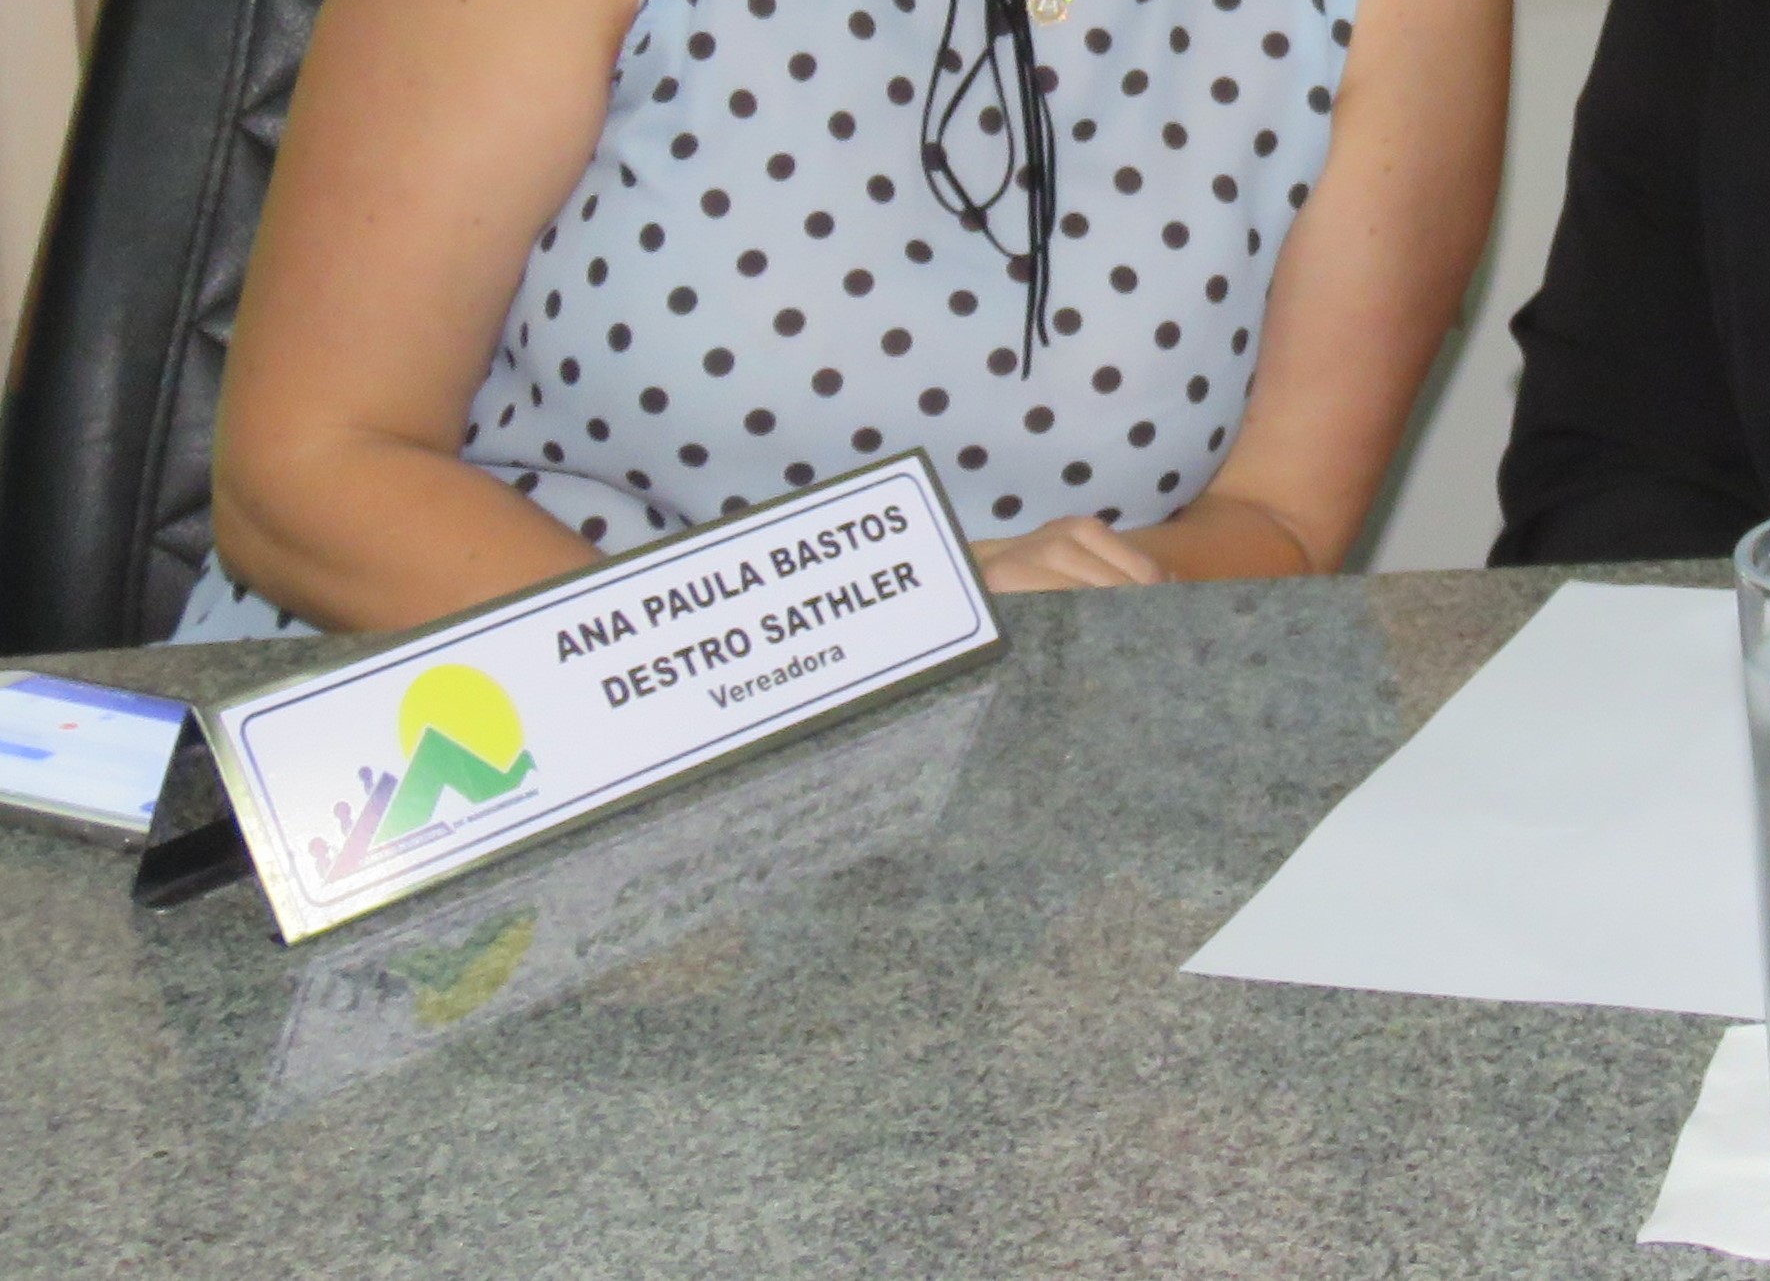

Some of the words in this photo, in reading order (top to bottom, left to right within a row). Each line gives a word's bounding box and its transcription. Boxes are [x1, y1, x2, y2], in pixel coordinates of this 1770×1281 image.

[557, 610, 637, 663] ANA
[642, 561, 765, 627] PAULA
[769, 505, 908, 579] BASTOS
[601, 627, 752, 708] DESTRO
[760, 562, 921, 644] SATHLER
[708, 644, 846, 708] Vereadora
